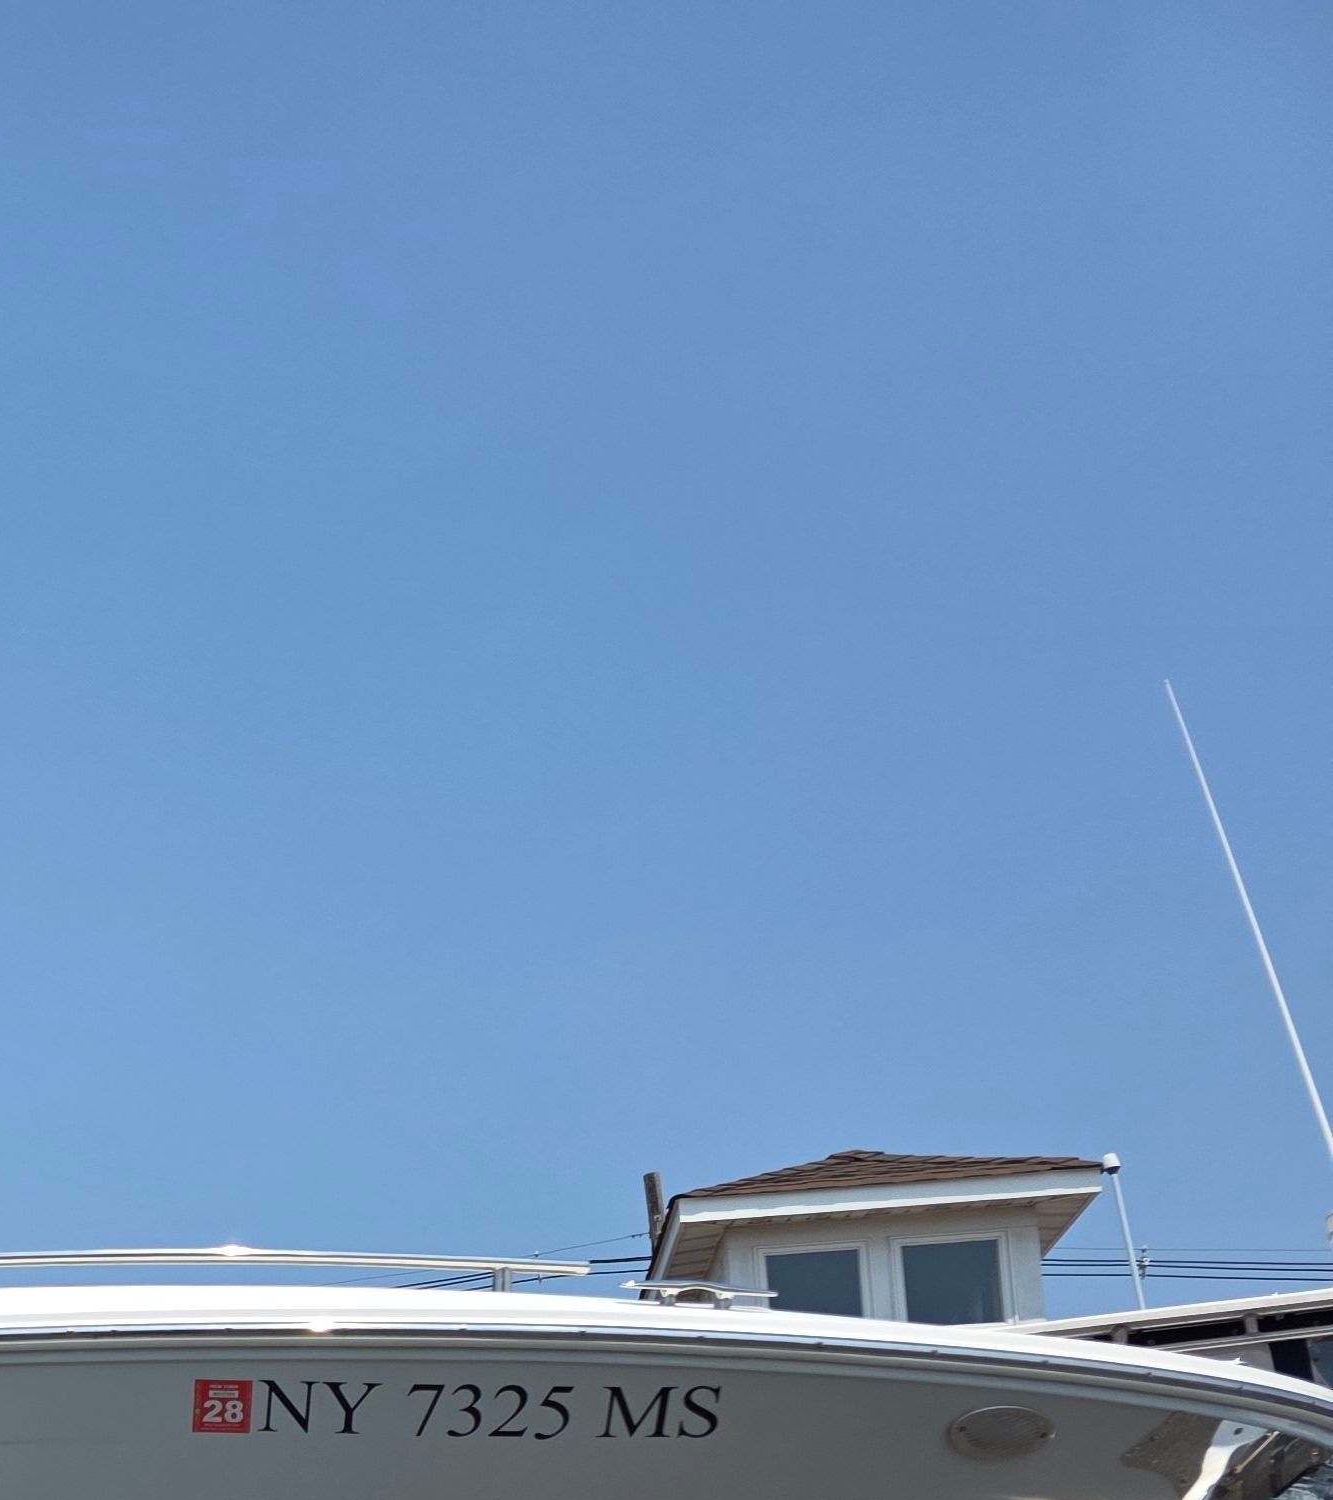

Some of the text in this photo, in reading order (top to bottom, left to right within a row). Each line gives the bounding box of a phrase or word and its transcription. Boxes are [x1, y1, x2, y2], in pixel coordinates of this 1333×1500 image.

[202, 1399, 244, 1423] 28
[257, 1379, 722, 1440] NY 7325 MS
